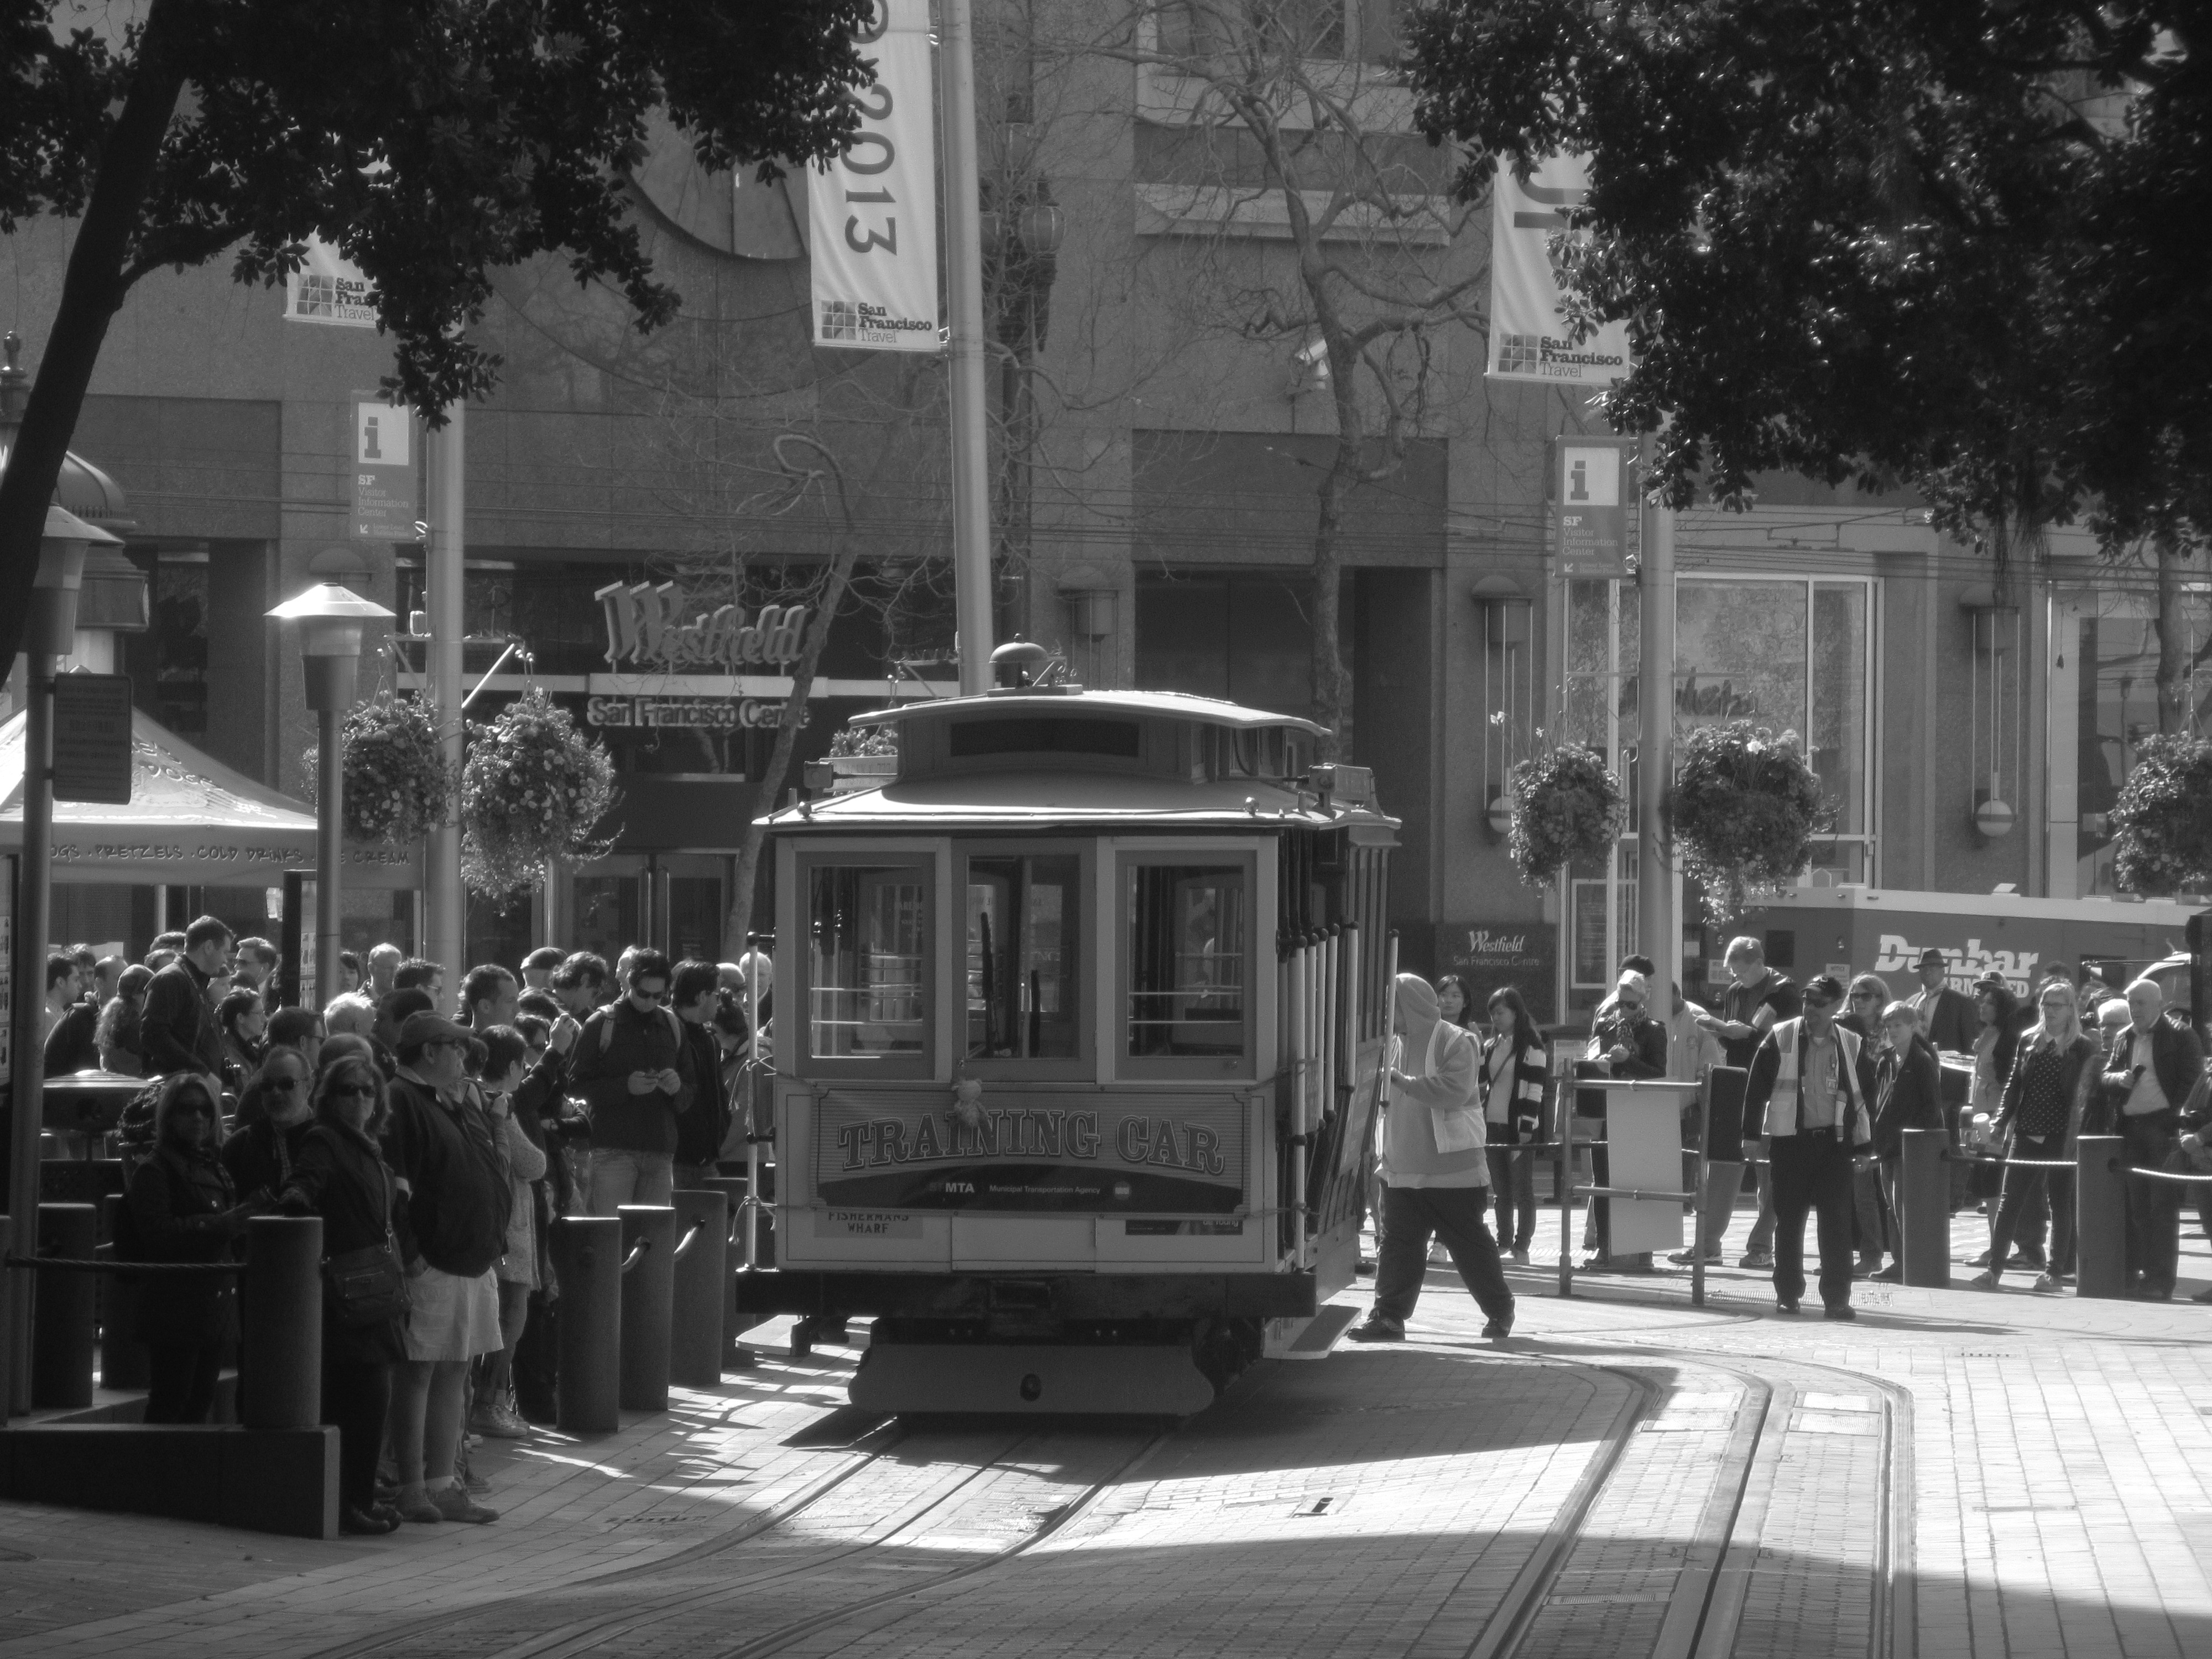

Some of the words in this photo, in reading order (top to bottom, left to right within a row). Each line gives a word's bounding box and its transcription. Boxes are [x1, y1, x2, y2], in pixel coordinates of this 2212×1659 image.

[840, 83, 897, 255] 2013
[336, 278, 365, 292] San
[335, 305, 375, 321] Travel
[858, 302, 886, 316] San
[859, 316, 932, 330] Francisco
[858, 328, 897, 343] Travel
[1541, 336, 1573, 350] San
[1540, 349, 1623, 366] Francisco
[1540, 362, 1582, 378] Travel
[358, 474, 375, 485] SF
[359, 487, 386, 497] Visitor
[359, 497, 409, 508] Information
[358, 507, 387, 517] Center
[1563, 516, 1582, 526] SF
[1563, 528, 1594, 536] Visitor
[1563, 537, 1618, 546] Information
[1562, 546, 1594, 555] Center
[594, 580, 811, 665] Westfield
[587, 697, 631, 726] San
[635, 697, 737, 727] Francisco
[95, 844, 184, 860] PRETZELS
[197, 845, 238, 861] COLD
[353, 851, 411, 865] CREAM
[1468, 930, 1526, 952] Westfield
[1453, 956, 1468, 966] San
[1471, 956, 1509, 966] Francisco
[1511, 956, 1540, 966] Cntre
[1875, 935, 2039, 978] Dunbar
[838, 1108, 1102, 1171] TRAINING
[1117, 1114, 1224, 1175] CAR
[989, 1185, 1022, 1194] Municipal
[1024, 1185, 1073, 1194] Transportation
[1075, 1186, 1100, 1196] Agency
[848, 1223, 889, 1233] WHARF
